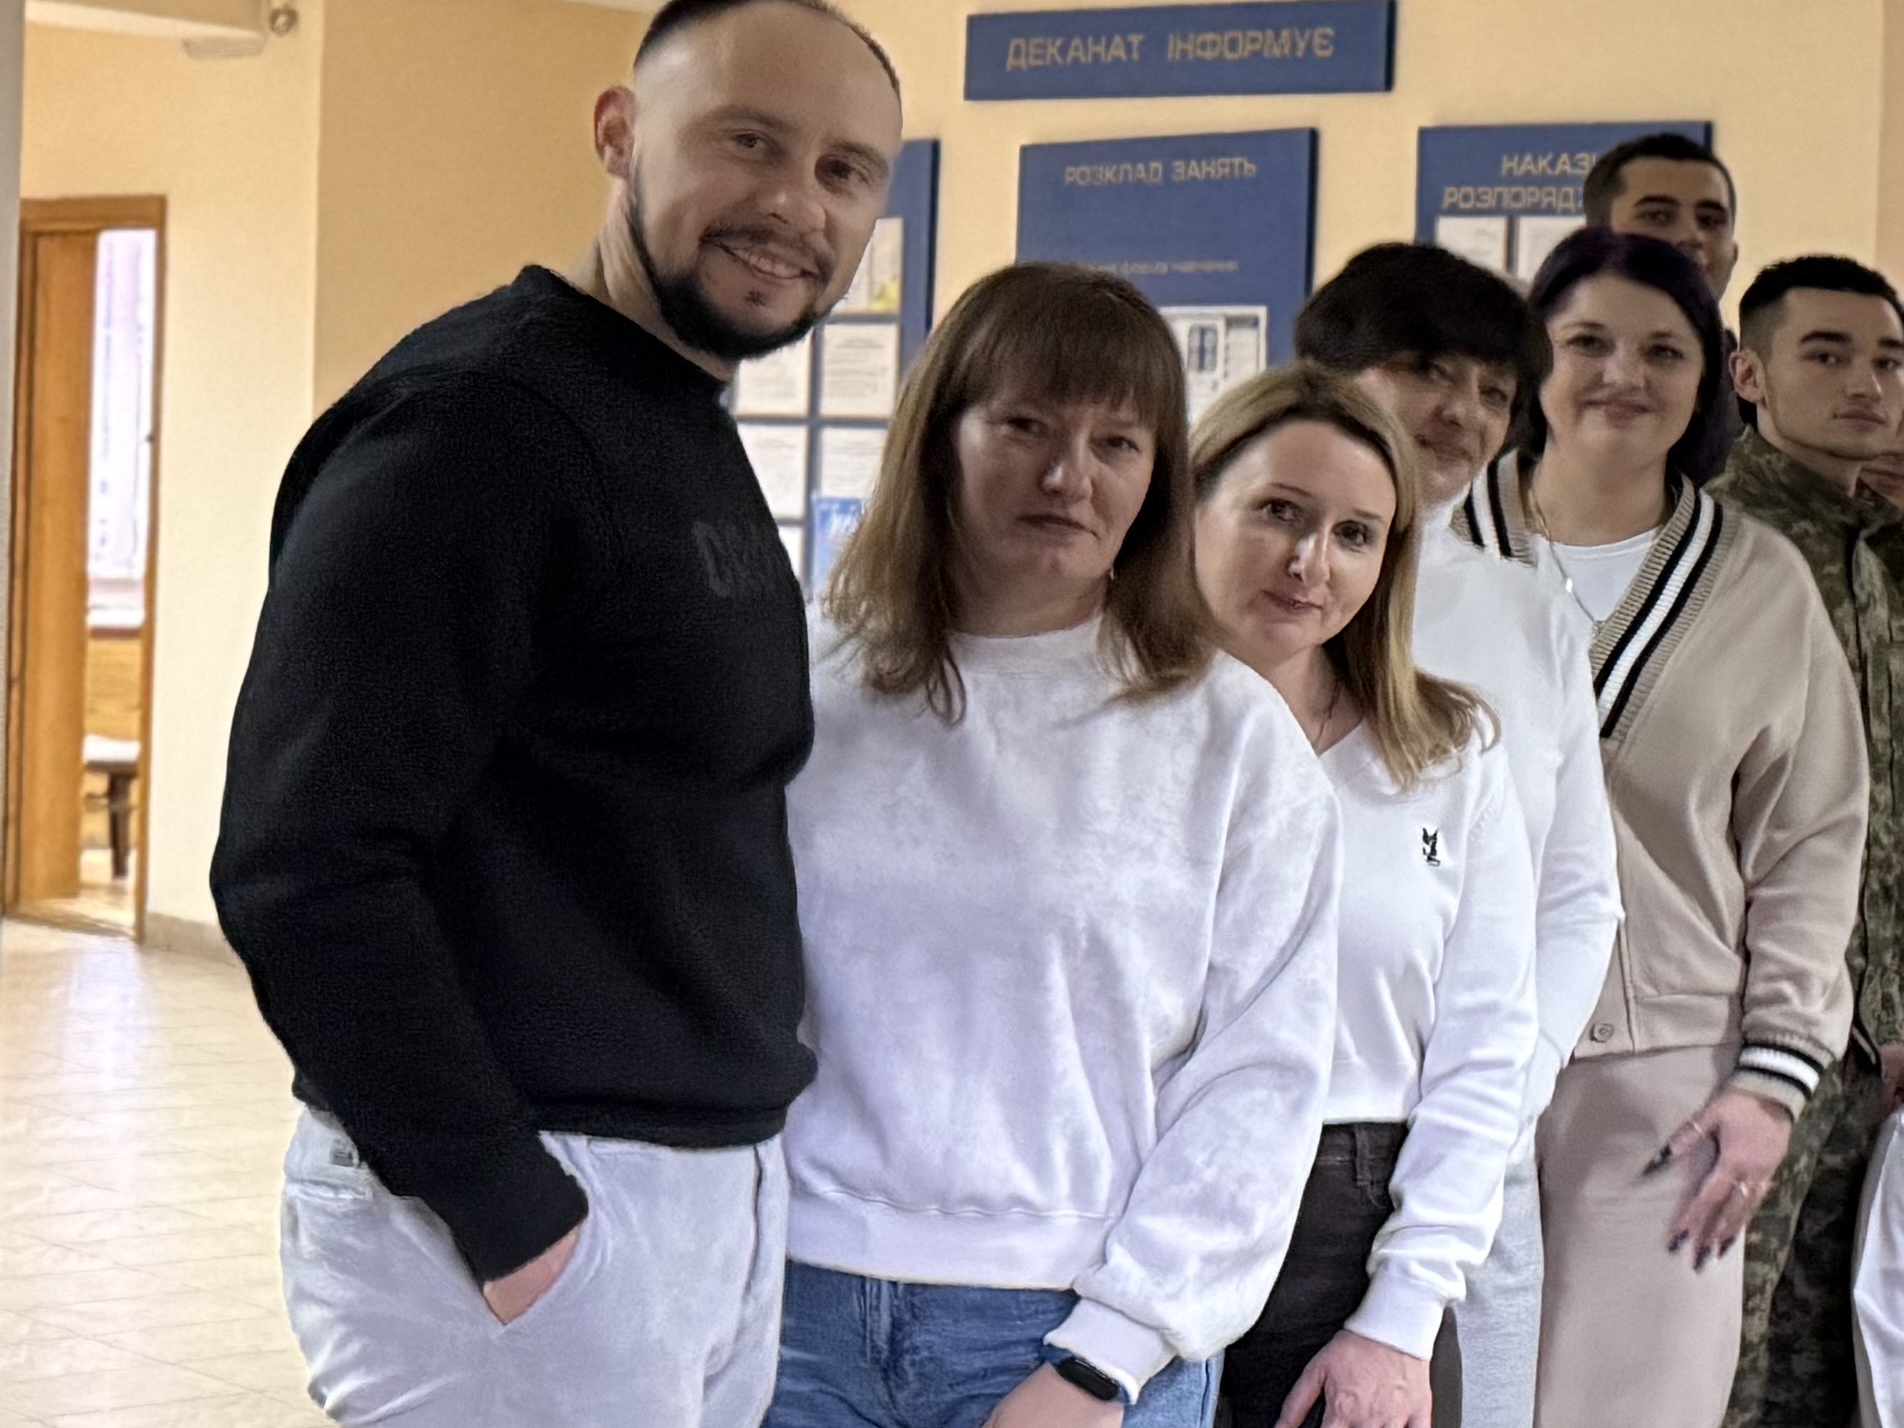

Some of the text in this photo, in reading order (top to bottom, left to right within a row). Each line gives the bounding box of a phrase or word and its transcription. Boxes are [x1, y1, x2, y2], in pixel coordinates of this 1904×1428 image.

[1006, 27, 1334, 71] ДЕКАНАТ ІНФОРМУЄ
[1064, 156, 1257, 186] РОЗКЛАД ЗАНЯТЬ
[1443, 185, 1584, 212] РОЗПОРЯД
